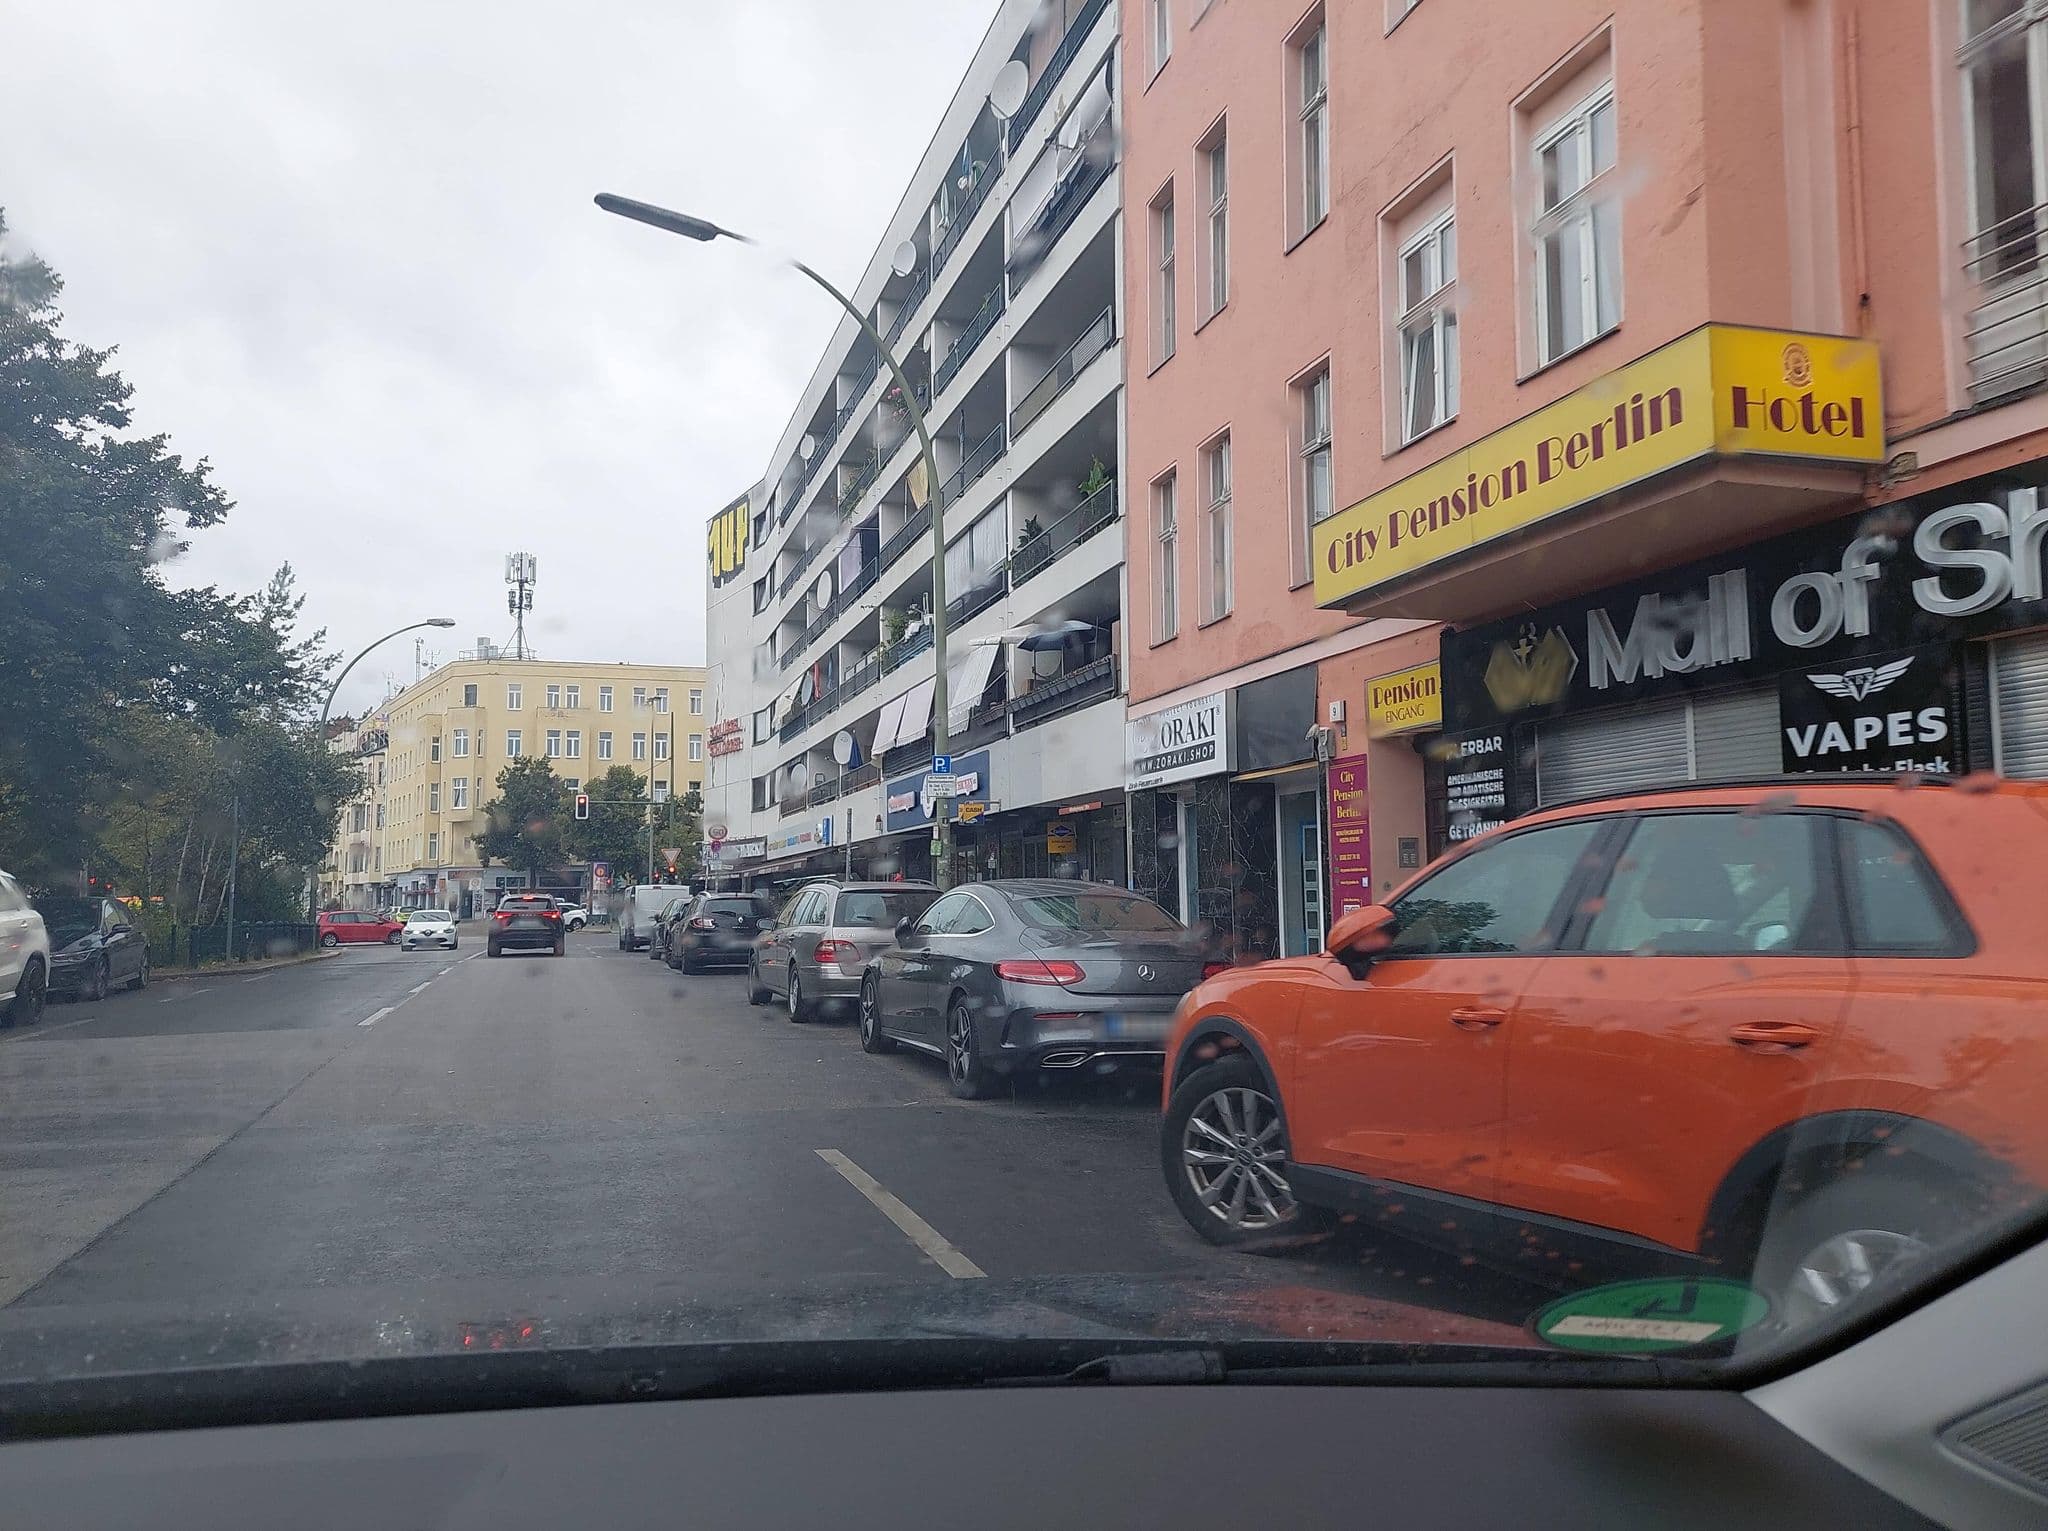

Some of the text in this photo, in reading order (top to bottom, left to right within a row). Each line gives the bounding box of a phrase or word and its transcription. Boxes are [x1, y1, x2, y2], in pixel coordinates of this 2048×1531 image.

[1732, 386, 1865, 438] Hotel
[1328, 387, 1682, 574] City Pension Berlin
[1587, 568, 1751, 689] Mall
[1771, 535, 1898, 648] of
[1373, 676, 1436, 709] Pension
[1152, 707, 1216, 748] ORAKI
[1386, 703, 1425, 723] EINGANG
[1785, 707, 1949, 758] VAPES
[935, 757, 945, 772] P
[1134, 744, 1214, 774] WW.ZORAKI.SHOP
[1447, 768, 1504, 786] AMERANISCHE
[1333, 788, 1363, 801] Pension
